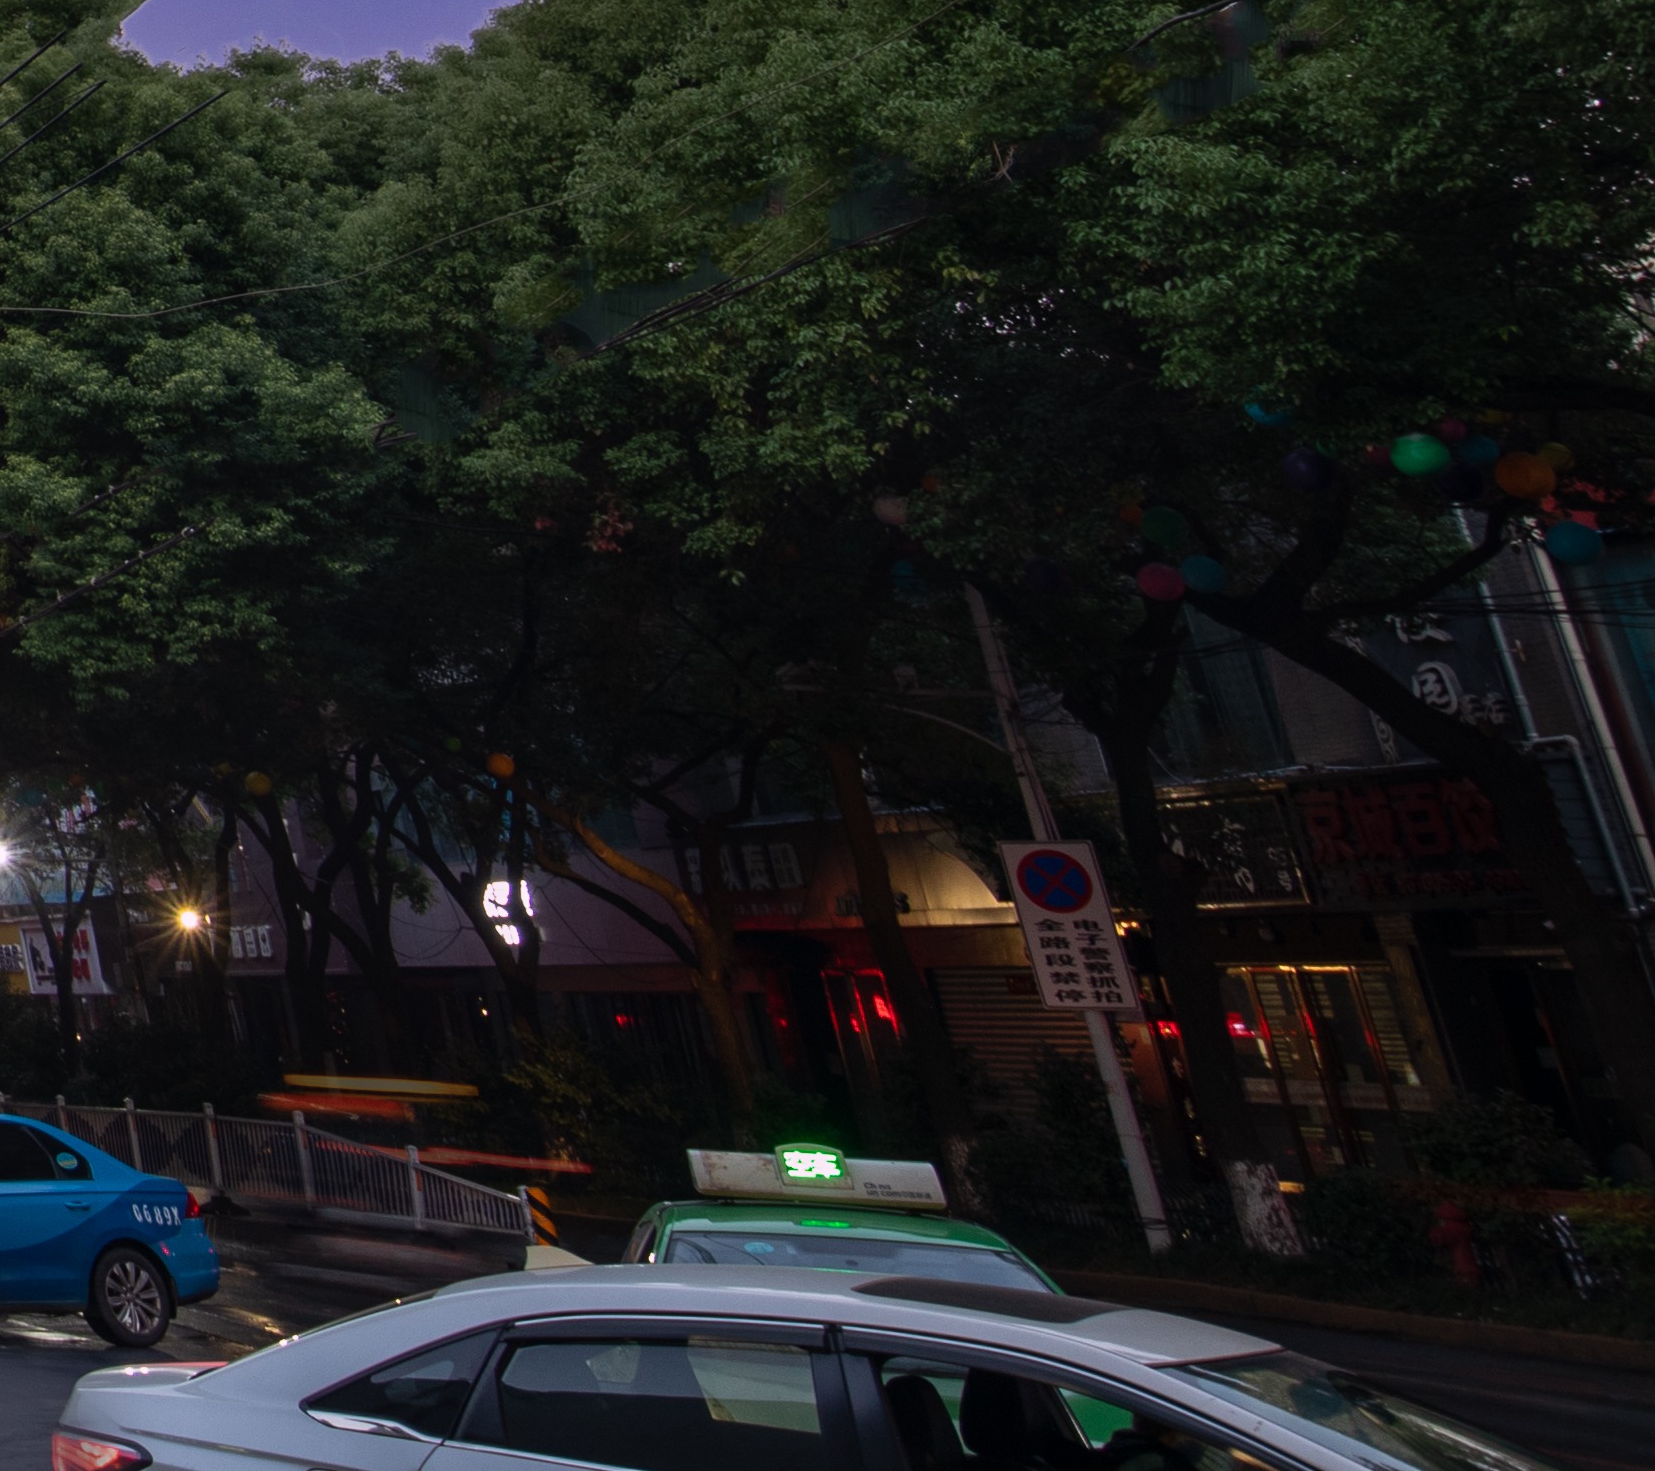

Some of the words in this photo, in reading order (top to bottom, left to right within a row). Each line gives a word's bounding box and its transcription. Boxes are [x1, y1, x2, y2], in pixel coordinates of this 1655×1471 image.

[1034, 918, 1087, 1003] 全路段禁停
[1072, 918, 1124, 1004] 电子警察抓拍
